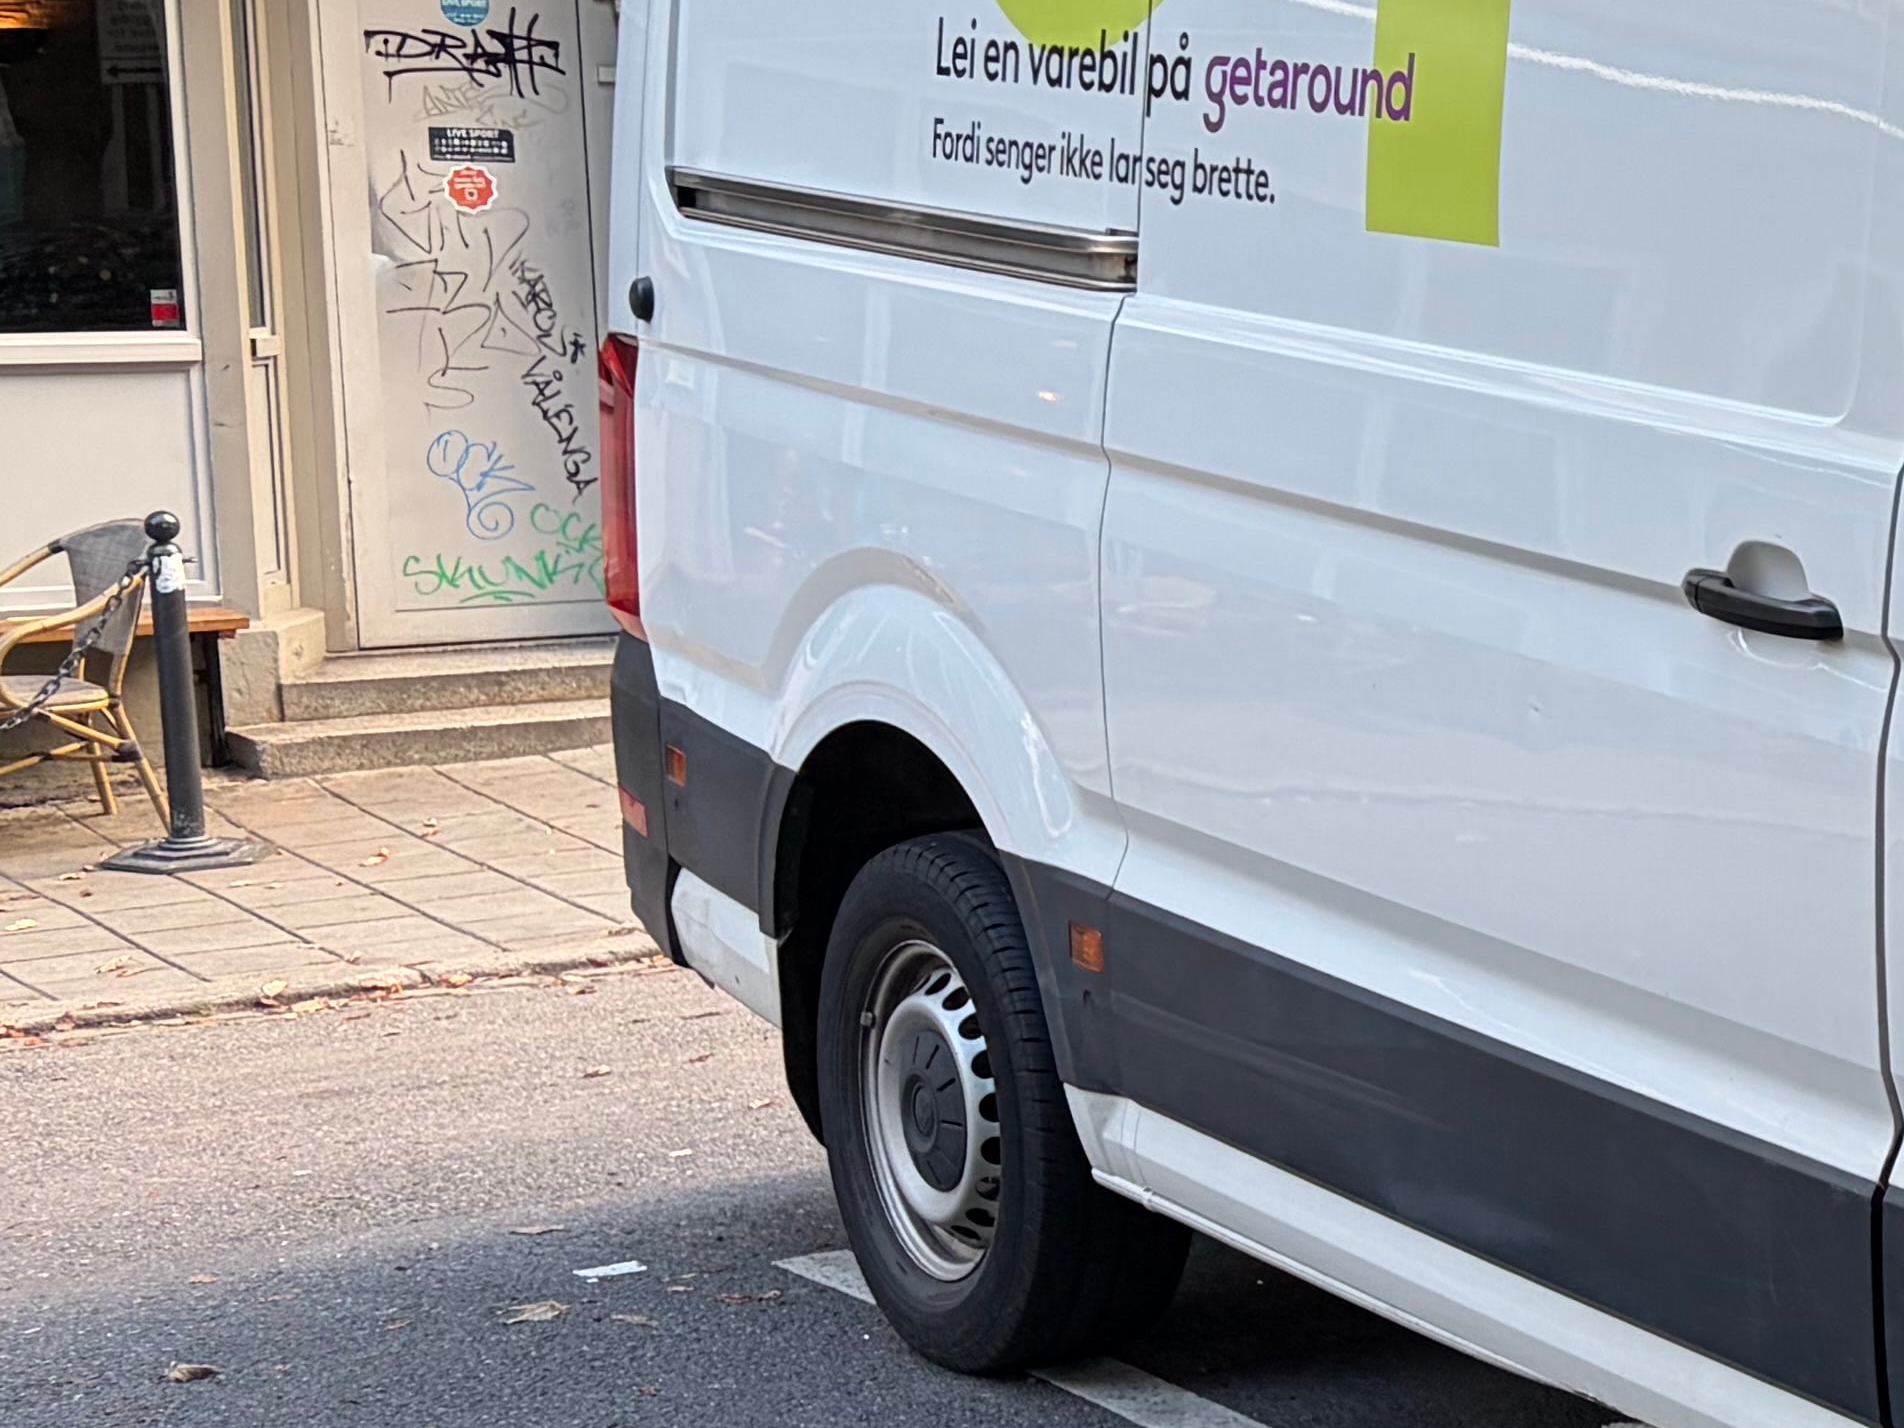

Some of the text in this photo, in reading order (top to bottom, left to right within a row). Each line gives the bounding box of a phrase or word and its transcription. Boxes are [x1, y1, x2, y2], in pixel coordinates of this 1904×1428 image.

[936, 17, 1415, 133] Lei en varebil på getaround
[932, 118, 1275, 206] Fordi senger ikke lar seg brette.
